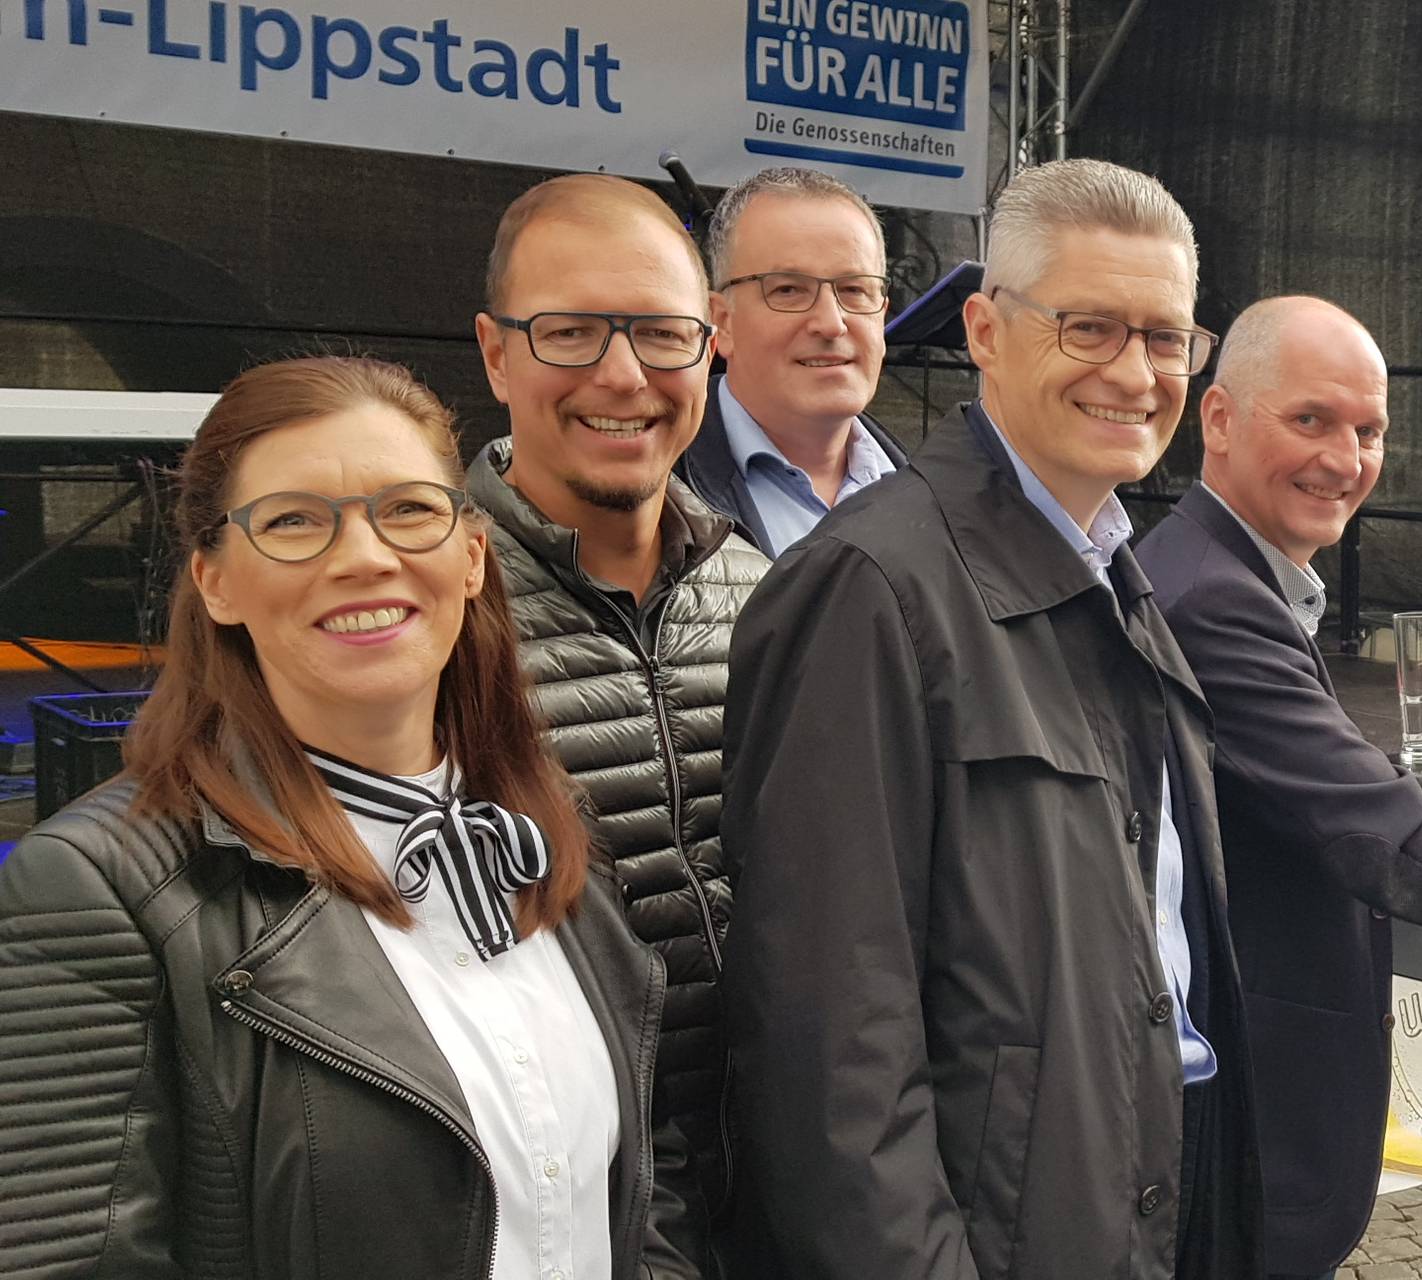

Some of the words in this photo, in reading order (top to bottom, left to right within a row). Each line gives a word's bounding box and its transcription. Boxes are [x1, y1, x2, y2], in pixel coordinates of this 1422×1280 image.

[757, 0, 816, 29] EIN
[826, 0, 962, 54] GEWINN
[756, 29, 847, 97] FÜR
[854, 54, 959, 114] ALLE
[756, 111, 786, 134] Die
[792, 117, 955, 157] Genossenschaften
